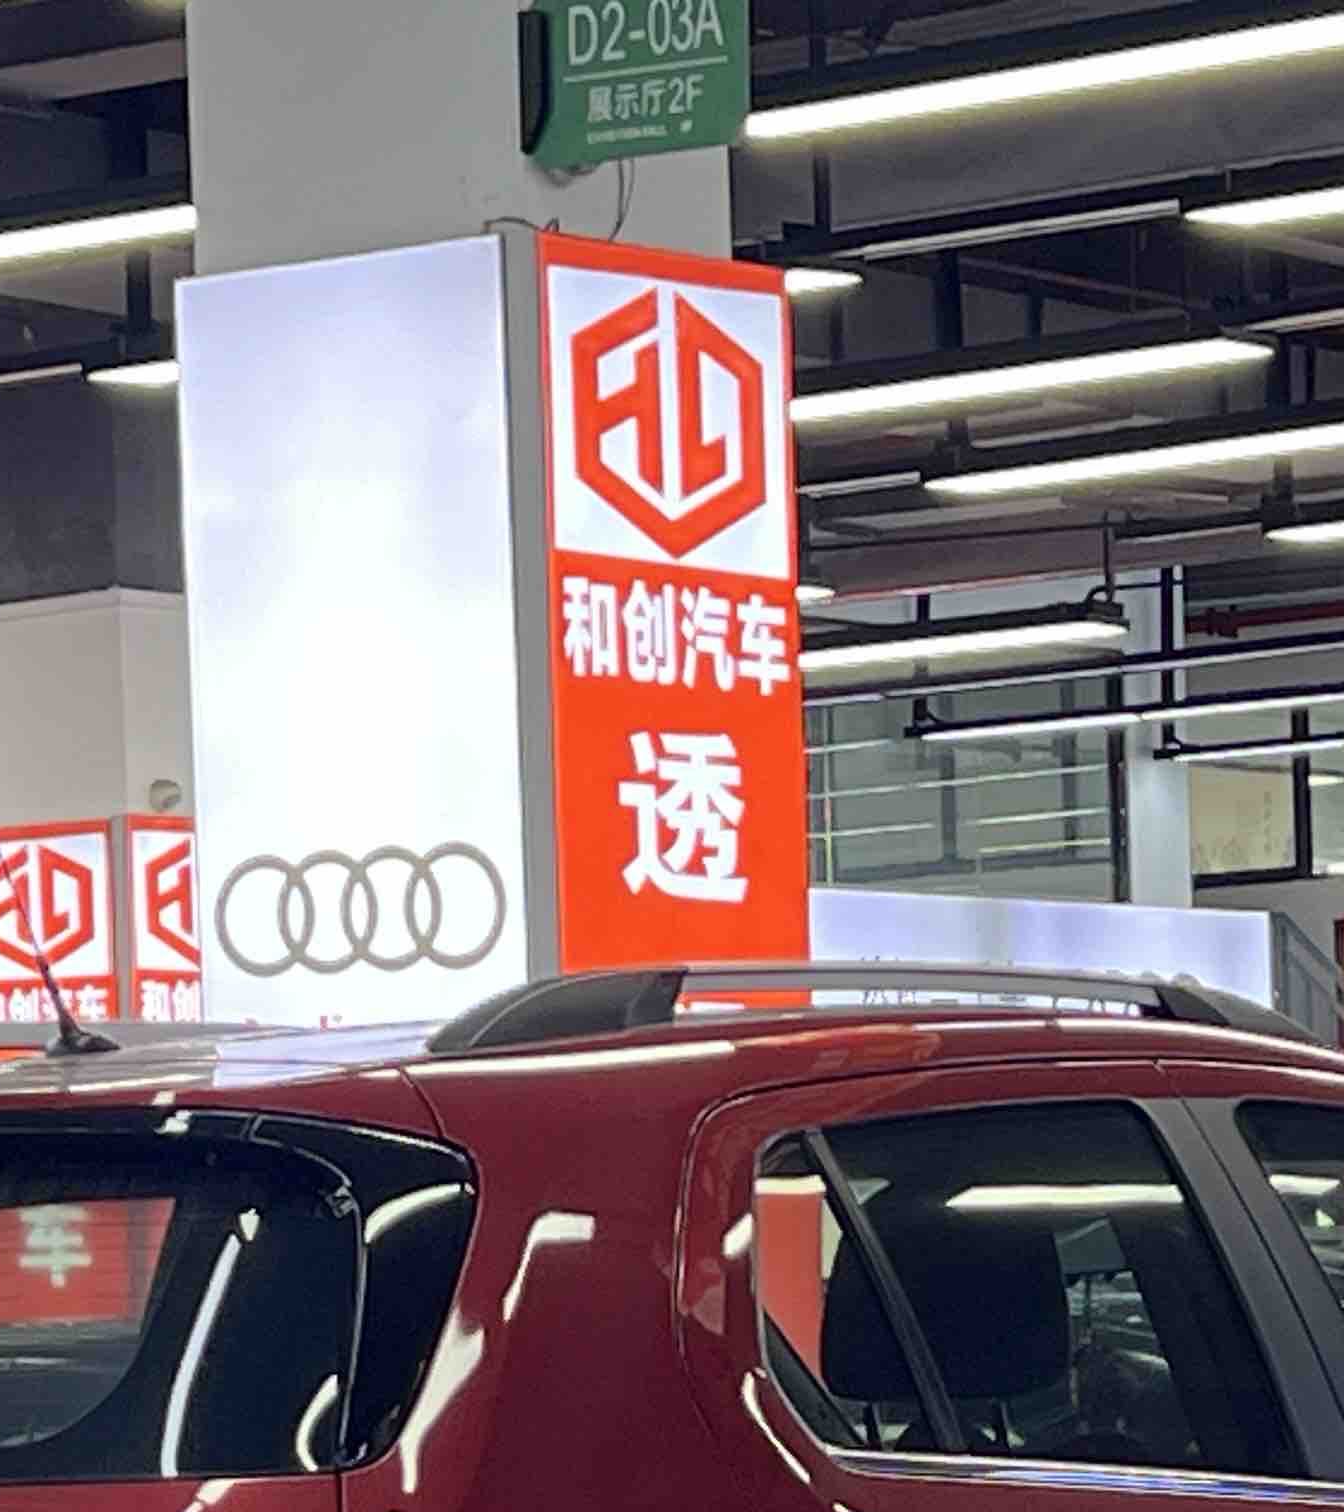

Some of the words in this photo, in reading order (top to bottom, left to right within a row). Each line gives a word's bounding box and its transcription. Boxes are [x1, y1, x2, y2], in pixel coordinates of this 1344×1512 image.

[568, 0, 724, 66] D2-03A
[587, 74, 704, 122] 展示厅2F
[562, 575, 791, 695] 和创汽车
[618, 731, 749, 902] 透
